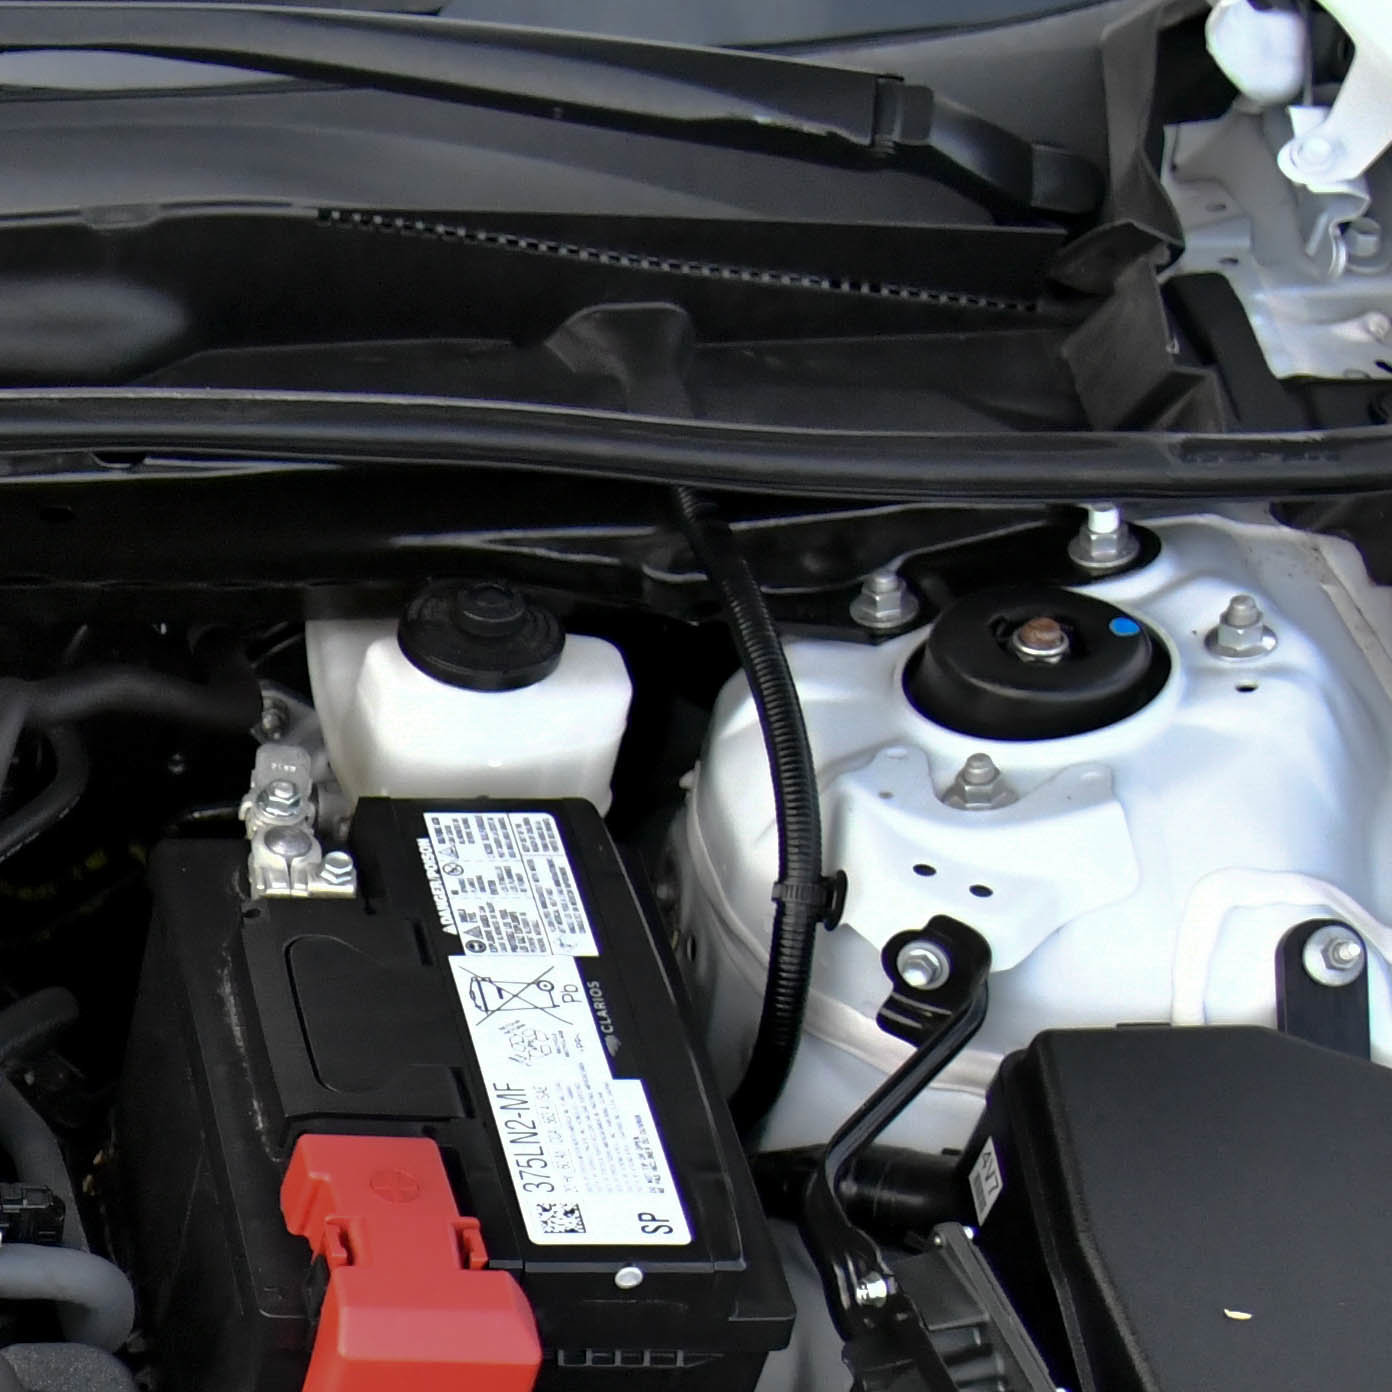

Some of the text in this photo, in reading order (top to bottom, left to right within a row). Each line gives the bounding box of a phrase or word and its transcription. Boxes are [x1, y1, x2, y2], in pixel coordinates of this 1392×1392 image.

[560, 984, 583, 1003] Pb
[587, 980, 615, 1034] CLARIOS
[492, 1082, 555, 1193] 375LN2-MF
[637, 1212, 674, 1235] SP
